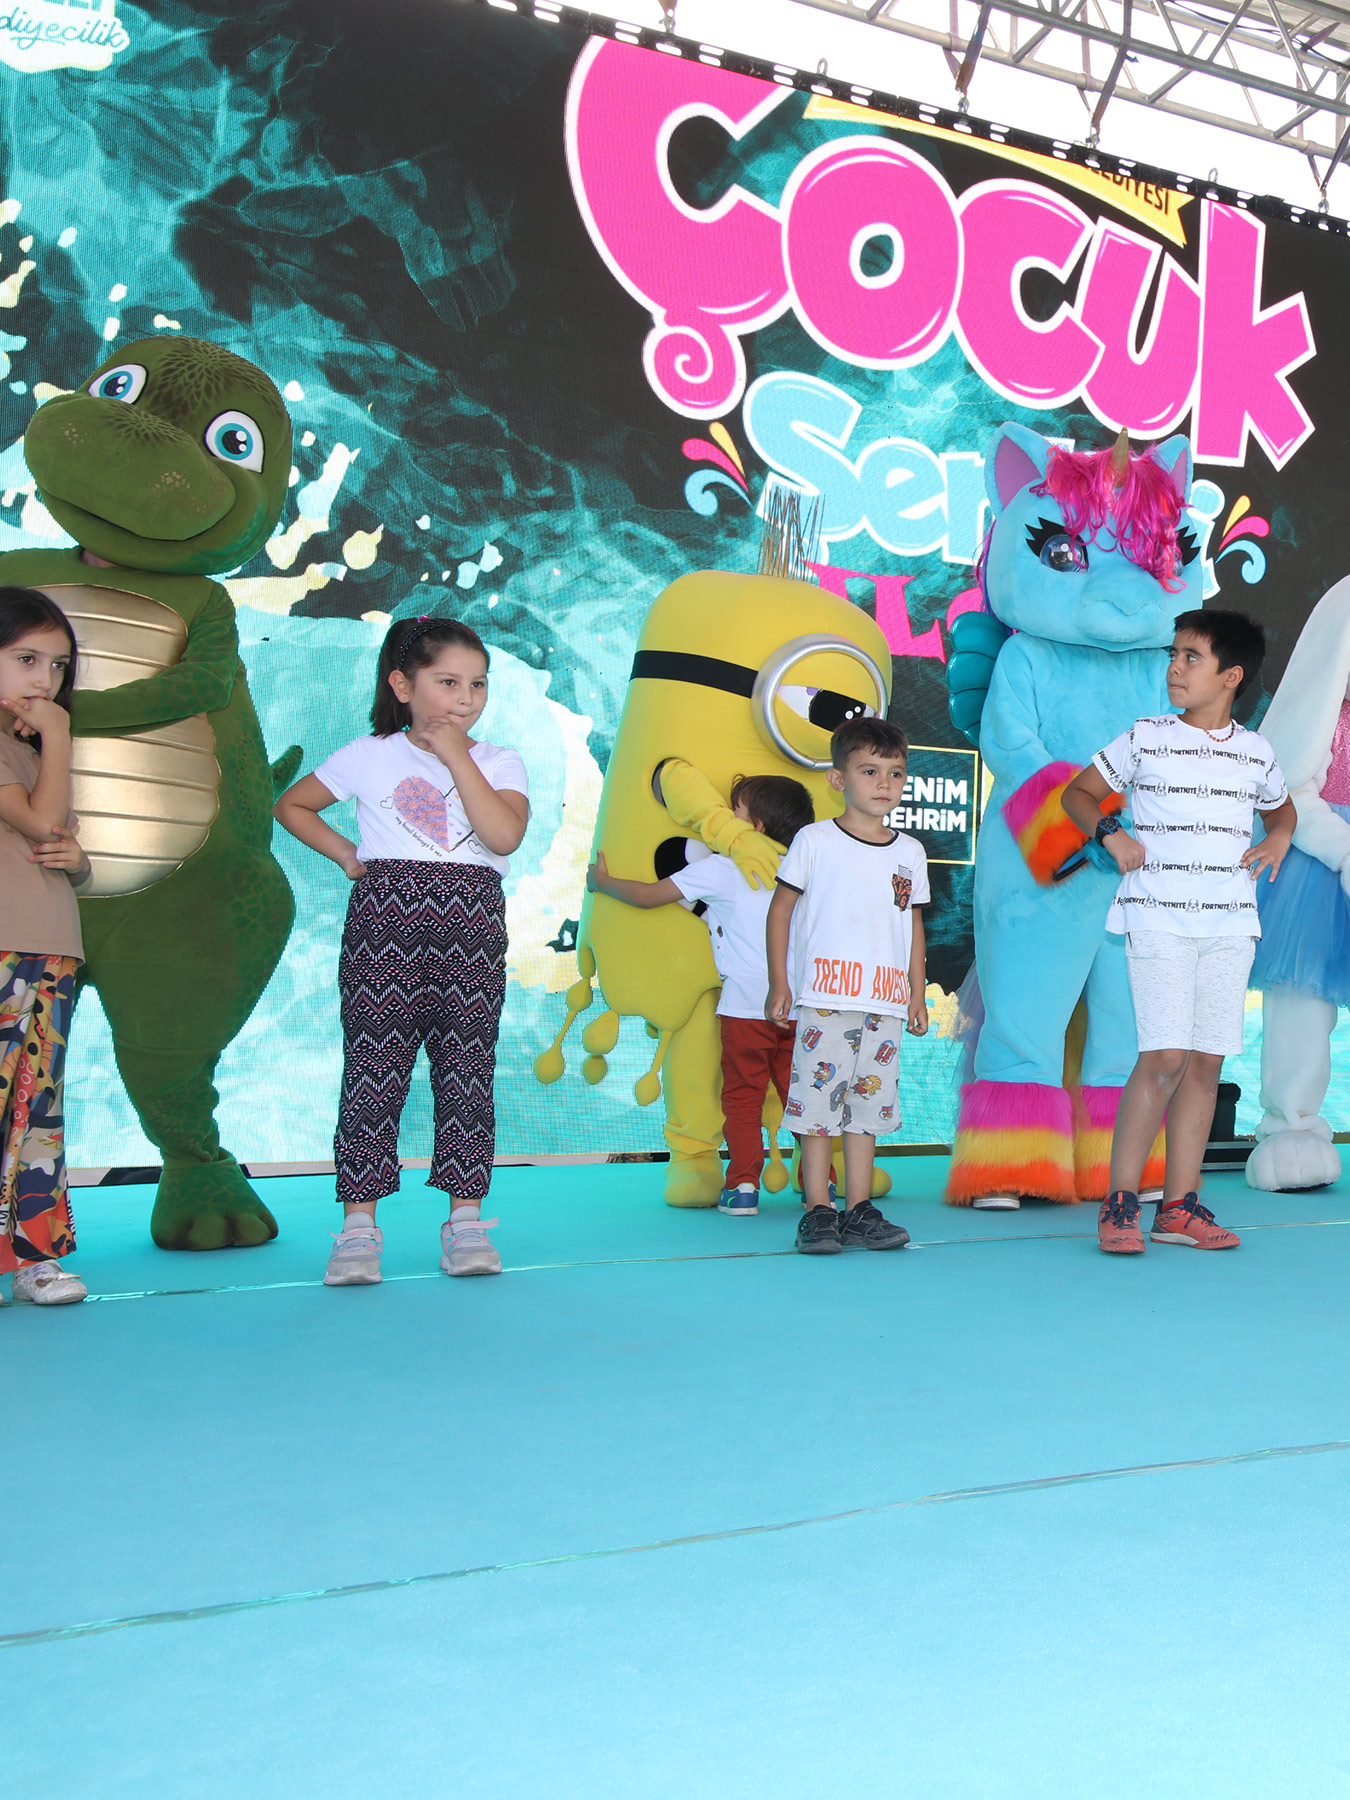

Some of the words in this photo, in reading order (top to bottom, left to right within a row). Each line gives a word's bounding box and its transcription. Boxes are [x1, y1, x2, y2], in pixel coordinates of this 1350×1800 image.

[0, 7, 125, 50] diyecilik
[1170, 748, 1199, 756] FORTNITE
[1212, 749, 1239, 761] FORTNITE
[1097, 750, 1118, 776] FORTNITE
[901, 775, 968, 805] ENİM
[1167, 785, 1197, 795] FORTNITE
[1210, 788, 1238, 799] FORTNITE
[1166, 824, 1195, 833] FORTNITE
[1208, 824, 1233, 834] FORTNITE
[1161, 863, 1190, 872] FORTNITE
[1204, 864, 1233, 873] FORTNITE
[1201, 902, 1230, 910] FORTNITE
[812, 957, 863, 997] TREND
